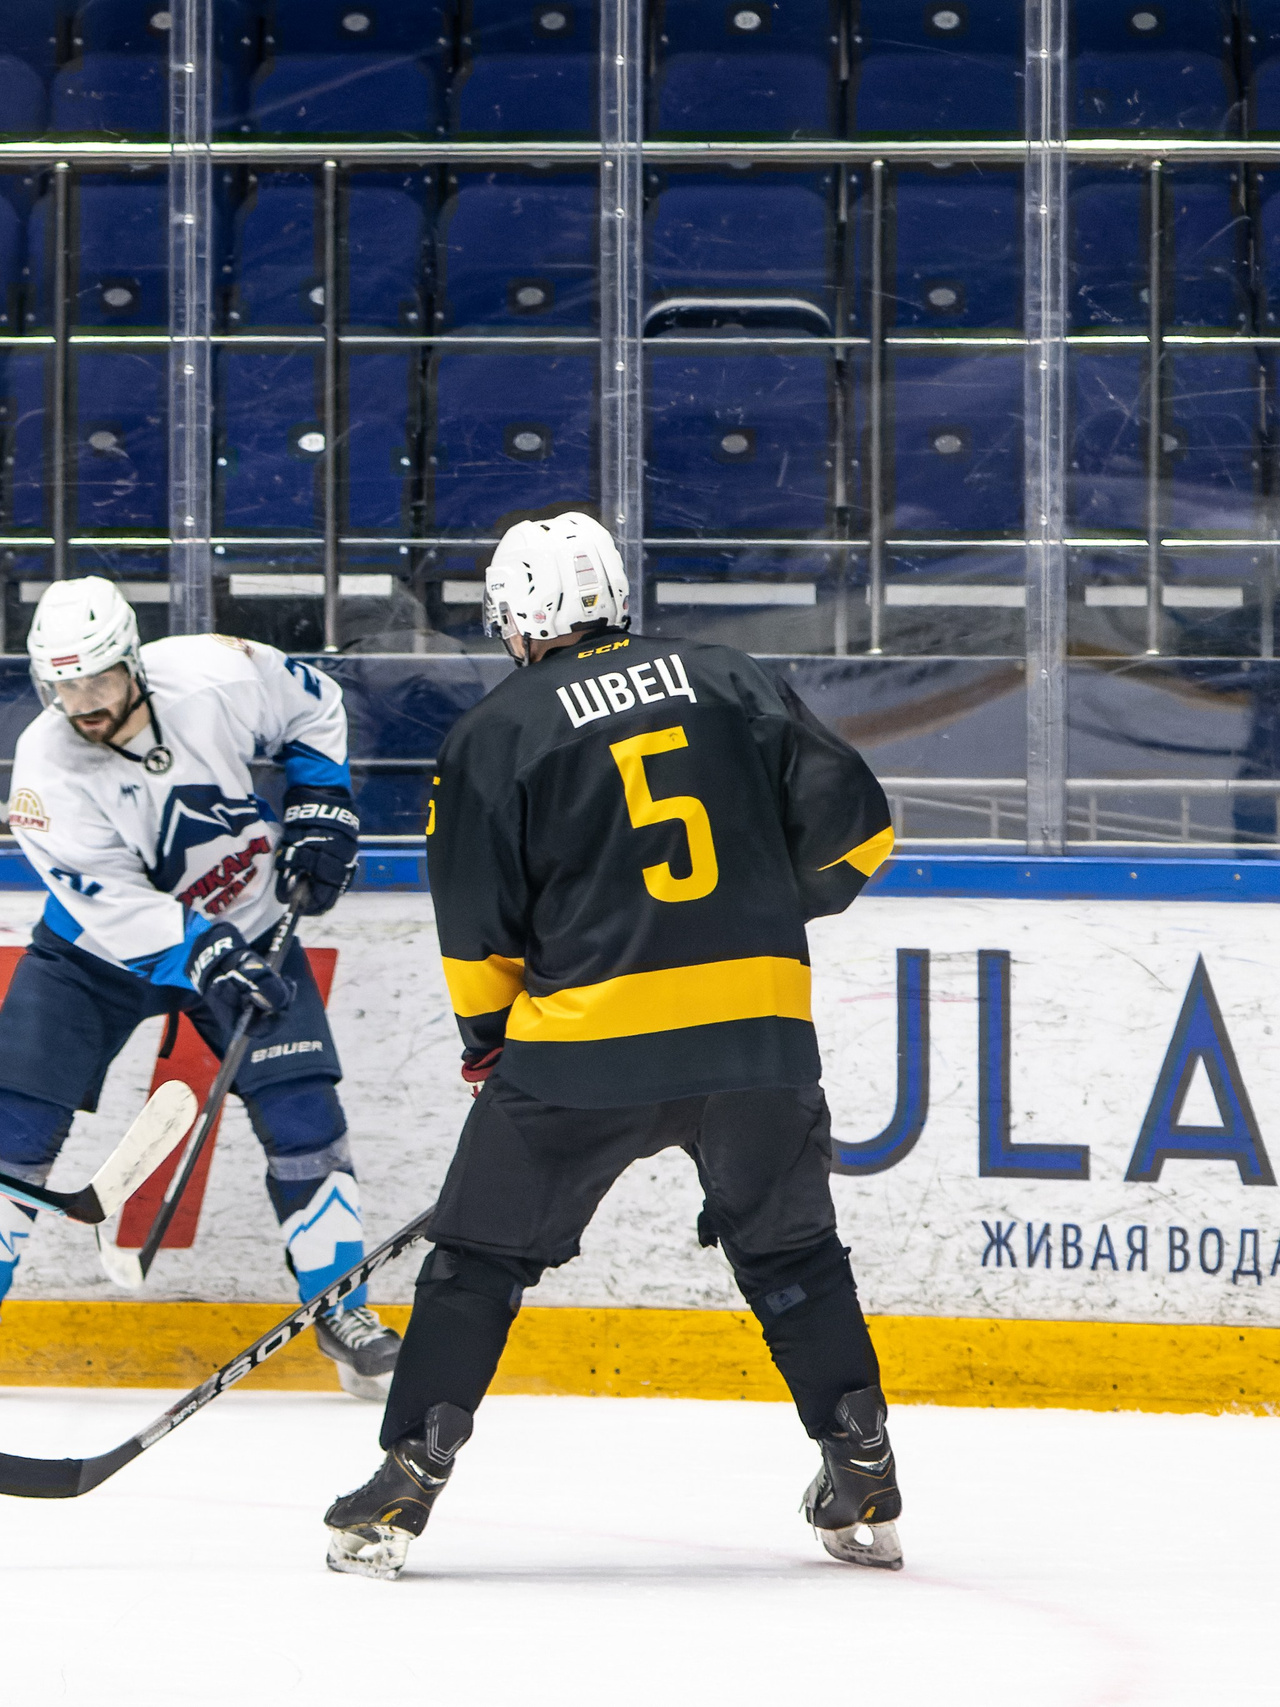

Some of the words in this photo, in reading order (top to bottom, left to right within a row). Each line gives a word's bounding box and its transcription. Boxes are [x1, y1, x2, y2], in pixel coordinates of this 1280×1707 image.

[577, 638, 630, 659] CCM
[556, 653, 697, 729] ШВЕЦ
[609, 725, 719, 903] 5
[251, 1040, 323, 1063] BAUER
[980, 1219, 1149, 1272] ЖИВАЯ
